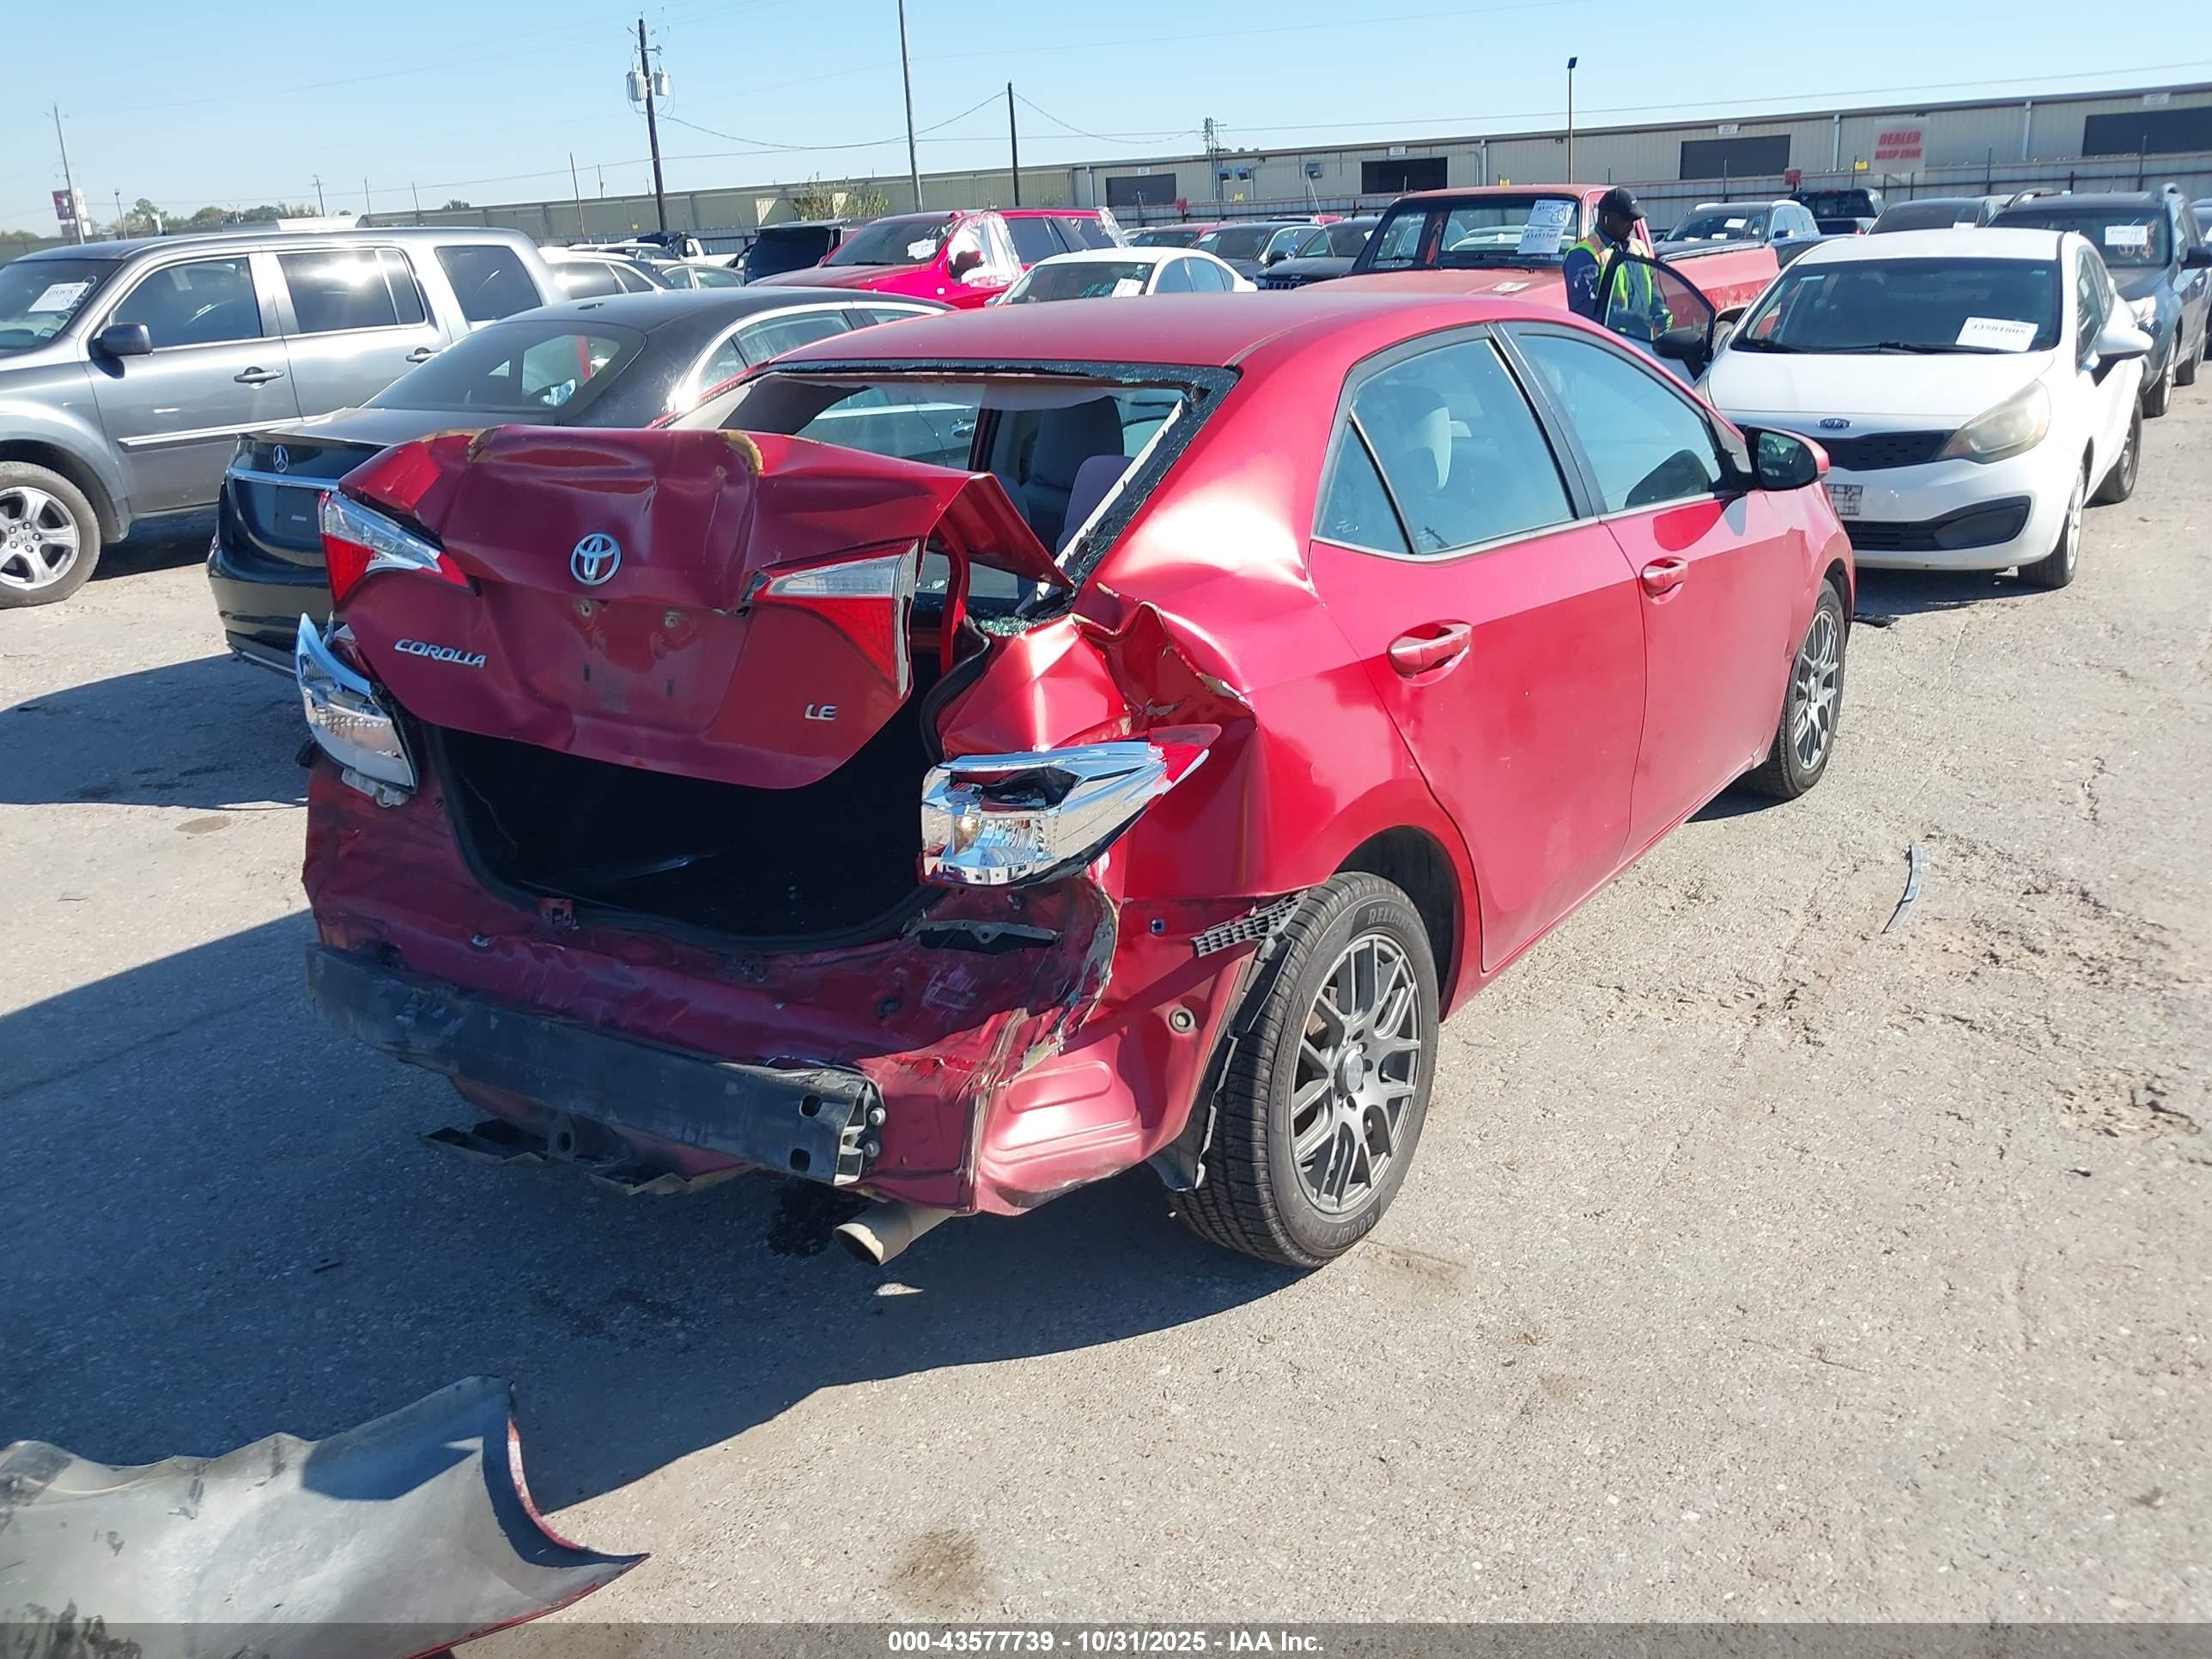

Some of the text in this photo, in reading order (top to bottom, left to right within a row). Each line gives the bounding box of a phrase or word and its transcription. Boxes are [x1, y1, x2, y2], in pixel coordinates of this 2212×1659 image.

[1879, 131, 1921, 145] DEALER
[394, 638, 486, 668] COROLLA
[805, 703, 838, 720] LE
